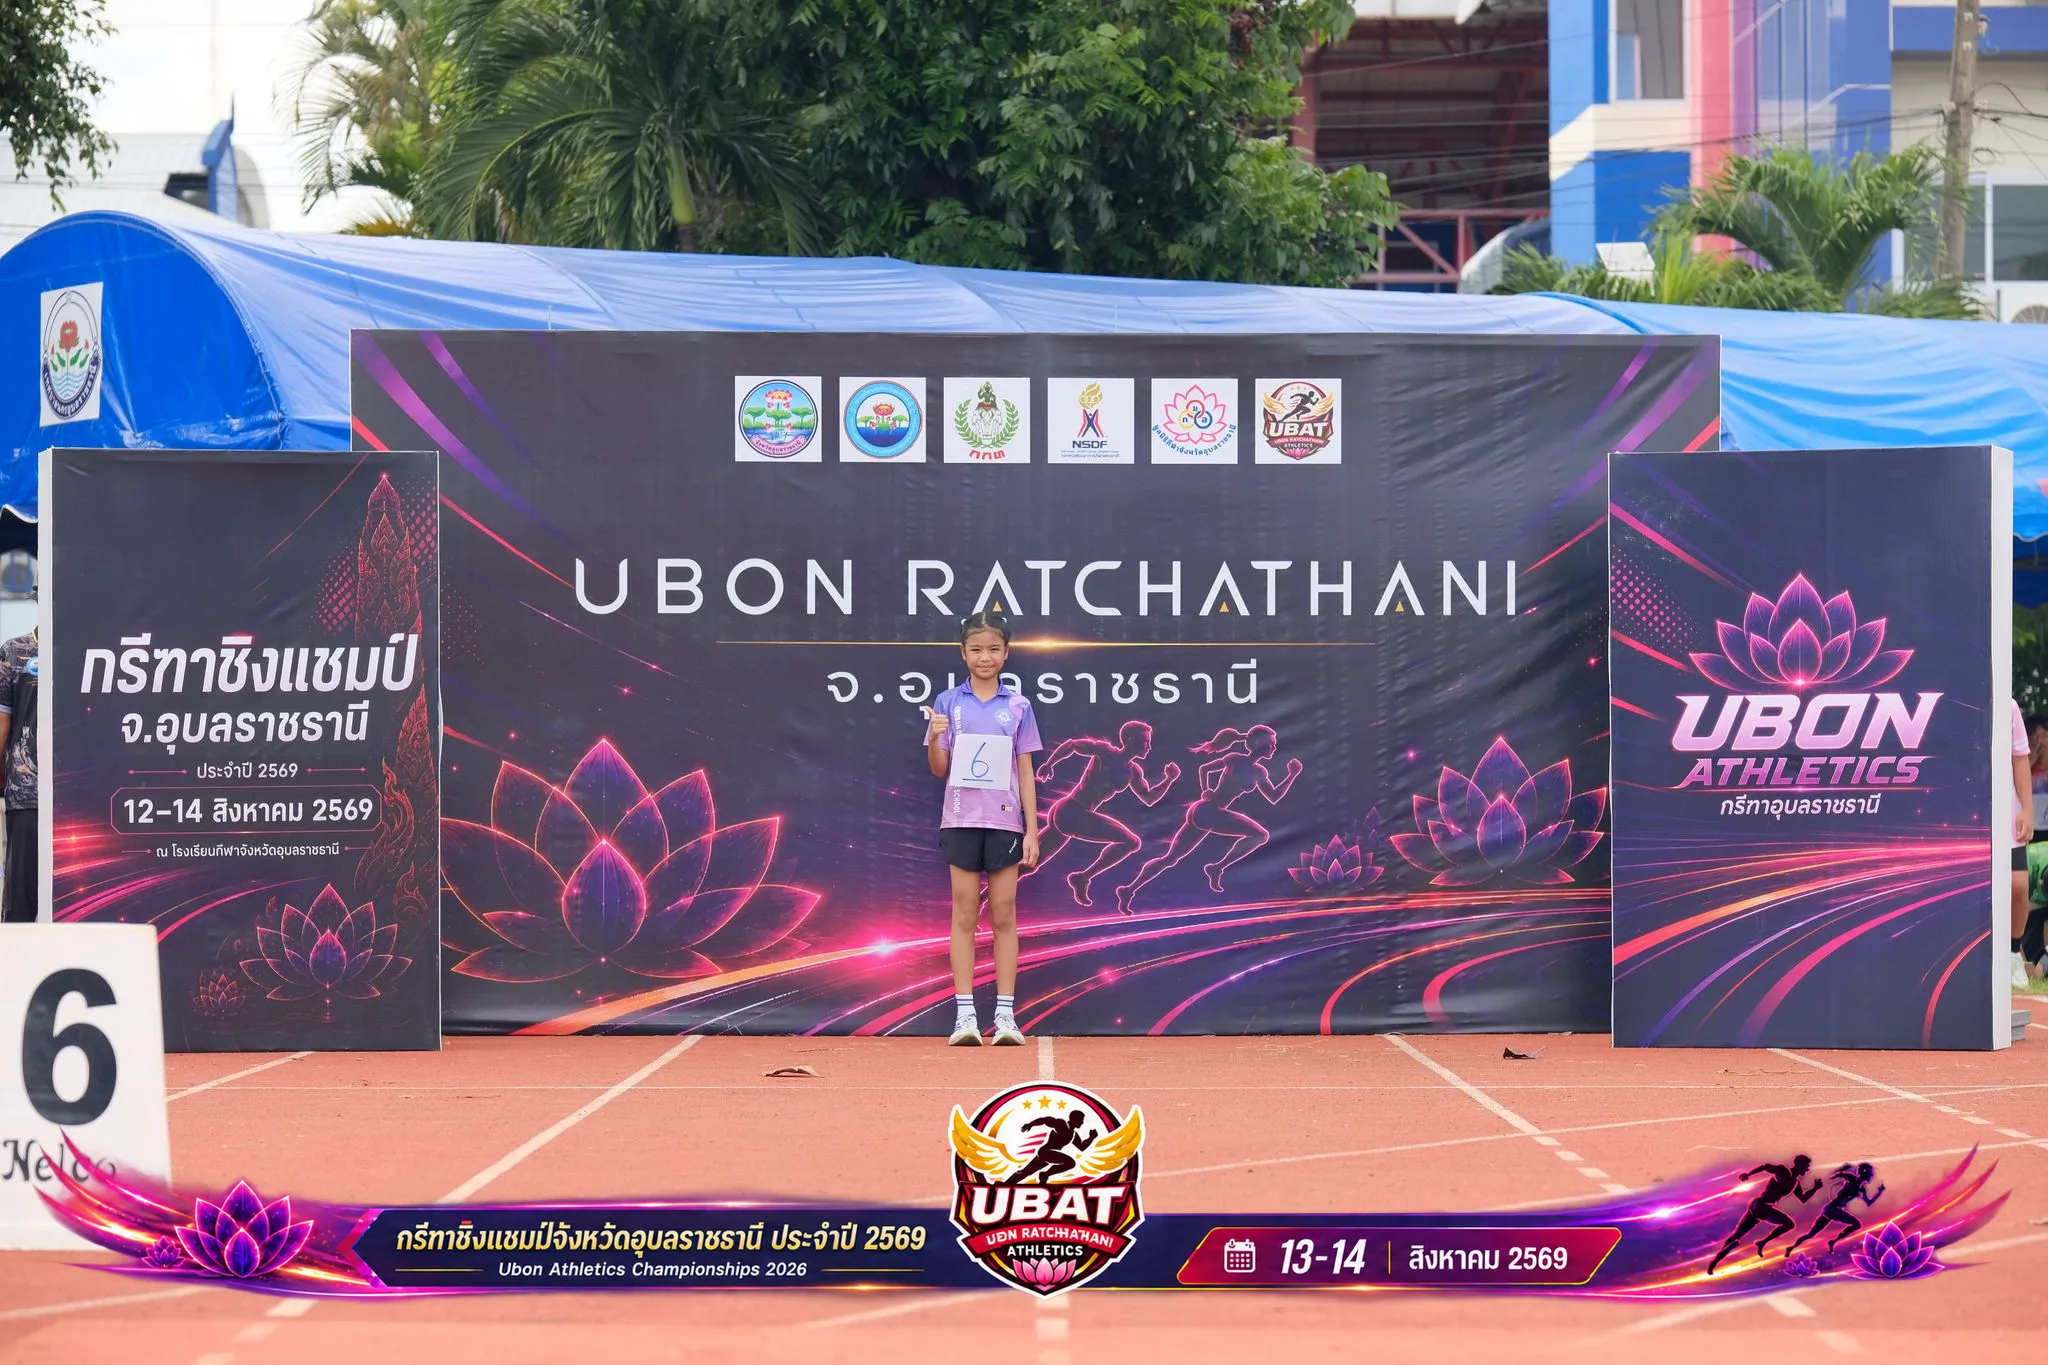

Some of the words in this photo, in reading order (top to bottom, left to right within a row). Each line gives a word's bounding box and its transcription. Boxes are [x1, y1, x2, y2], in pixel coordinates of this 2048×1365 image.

[1072, 440, 1108, 449] NSDF
[1269, 422, 1329, 437] UBAT
[575, 557, 852, 615] UBON
[907, 559, 1516, 616] RATCHATHANI
[80, 632, 419, 694] กรีฑาชิงแชมป์
[121, 699, 370, 756] จ.อุบลราชธานี
[1671, 692, 1945, 751] UBON
[196, 761, 252, 779] ประจำปี
[258, 762, 299, 778] 2569
[970, 741, 990, 779] 6
[1680, 755, 1932, 788] ATHLETICS
[123, 798, 203, 824] 12-14
[212, 797, 303, 823] สิงหาคม
[312, 798, 374, 822] 2569
[953, 789, 961, 815] SCHOOL
[1719, 792, 1882, 821] กรีฑาอุบลราชธานี
[156, 846, 168, 858] ณ
[172, 841, 340, 861] โรงเรียนกีฬาจังหวัดอุบลราชธานี
[21, 967, 119, 1126] 6
